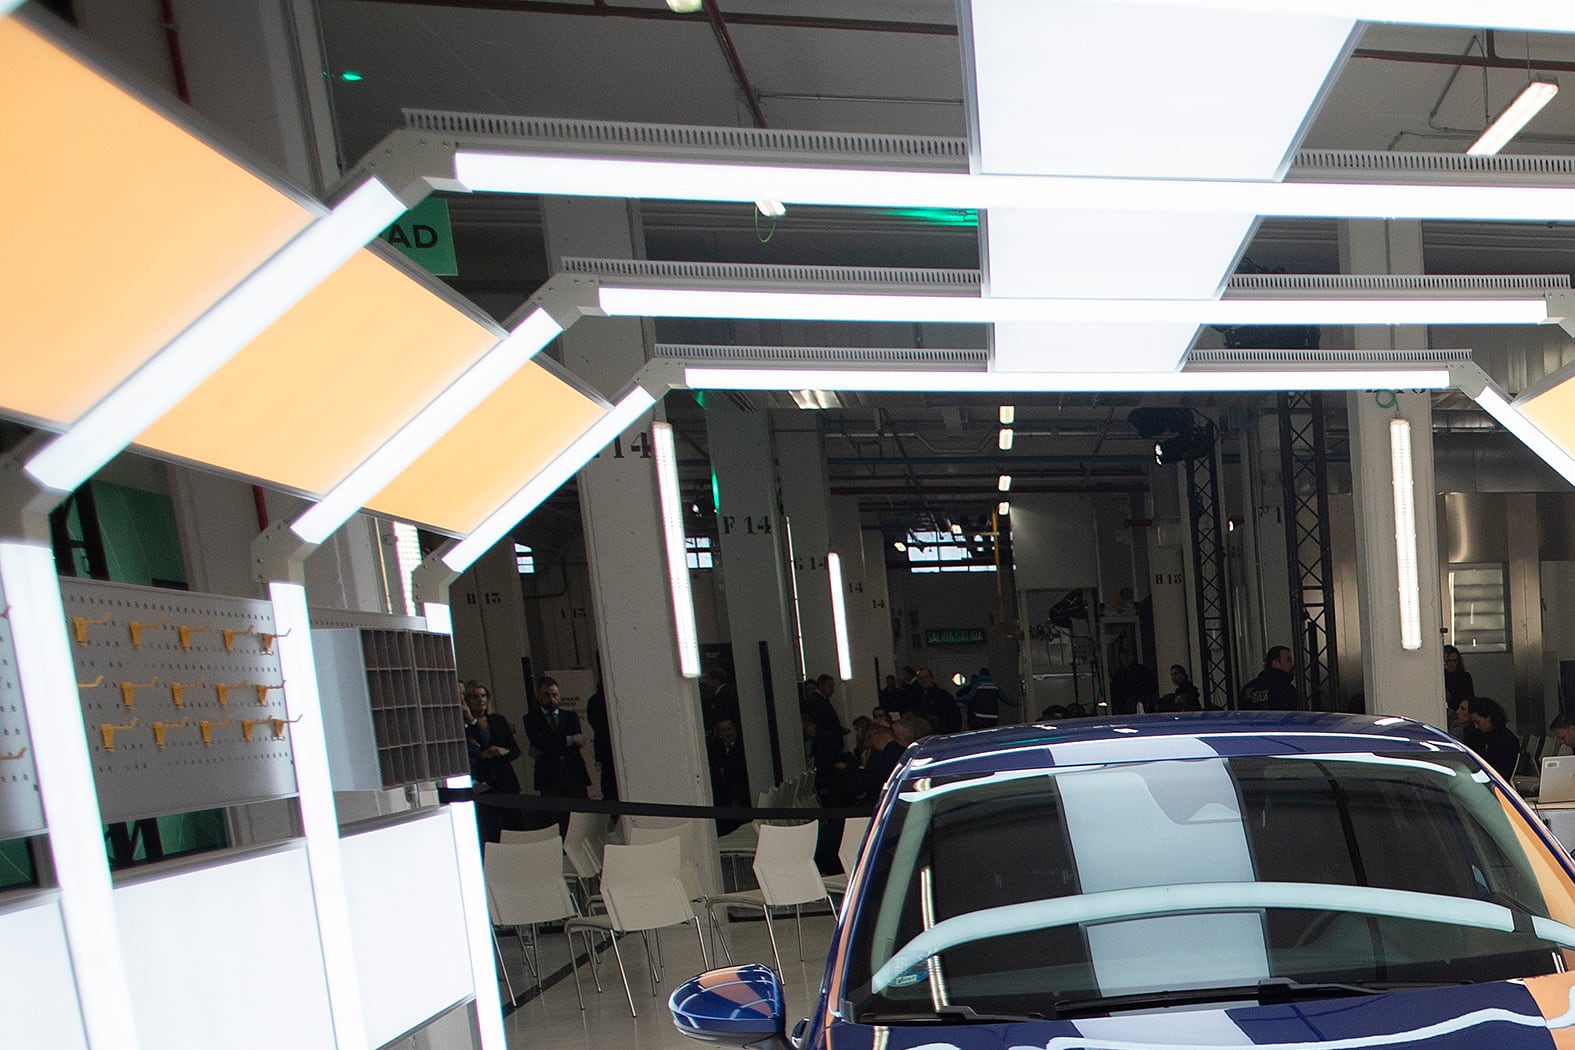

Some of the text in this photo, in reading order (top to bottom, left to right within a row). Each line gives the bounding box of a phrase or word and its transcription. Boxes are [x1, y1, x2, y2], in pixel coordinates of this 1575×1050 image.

[614, 432, 651, 458] 14
[722, 515, 771, 534] F 14
